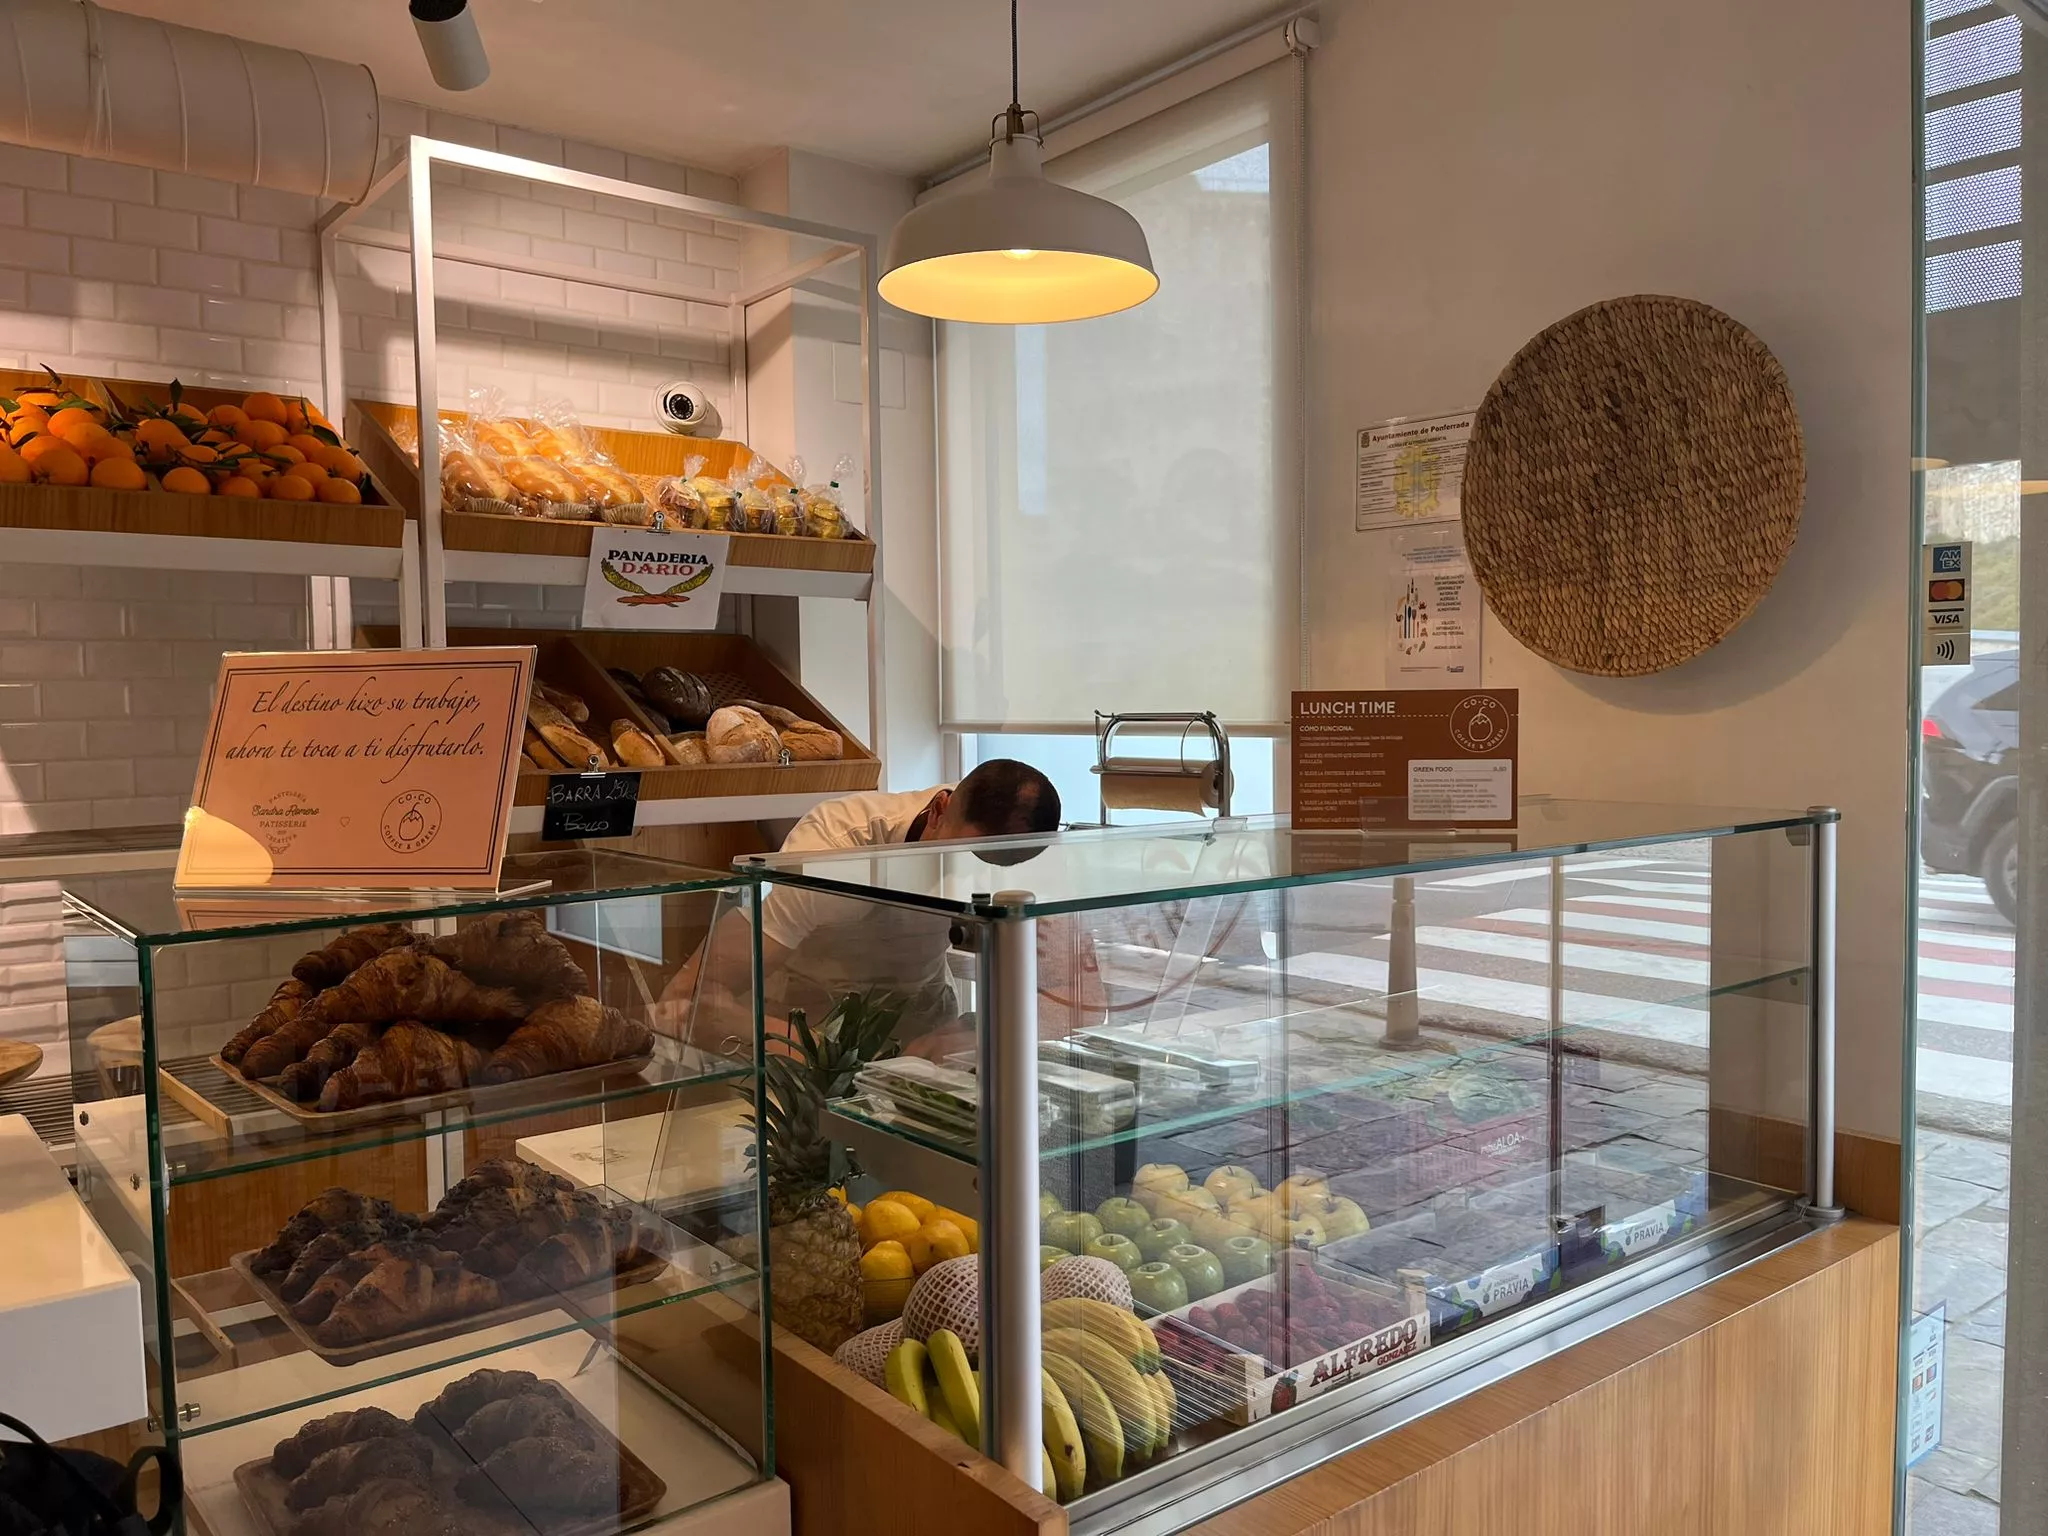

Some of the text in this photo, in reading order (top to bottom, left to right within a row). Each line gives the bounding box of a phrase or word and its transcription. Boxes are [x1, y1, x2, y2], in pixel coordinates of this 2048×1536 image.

[1372, 421, 1470, 442] Ayuntamiento de Ponferrada
[608, 549, 709, 565] PANADERIA
[621, 562, 695, 576] DARIO
[1932, 614, 1960, 624] VISA
[252, 676, 481, 725] El destino hizo su trabajo,
[1300, 701, 1396, 715] LUNCH TIME
[225, 719, 485, 784] ahora te toca a ti disfrutarlo.
[251, 804, 320, 817] Sandra Romero
[1633, 1222, 1664, 1244] PRAVIA
[1493, 1278, 1529, 1301] PRAVIA
[1309, 1318, 1418, 1388] ALFREDO
